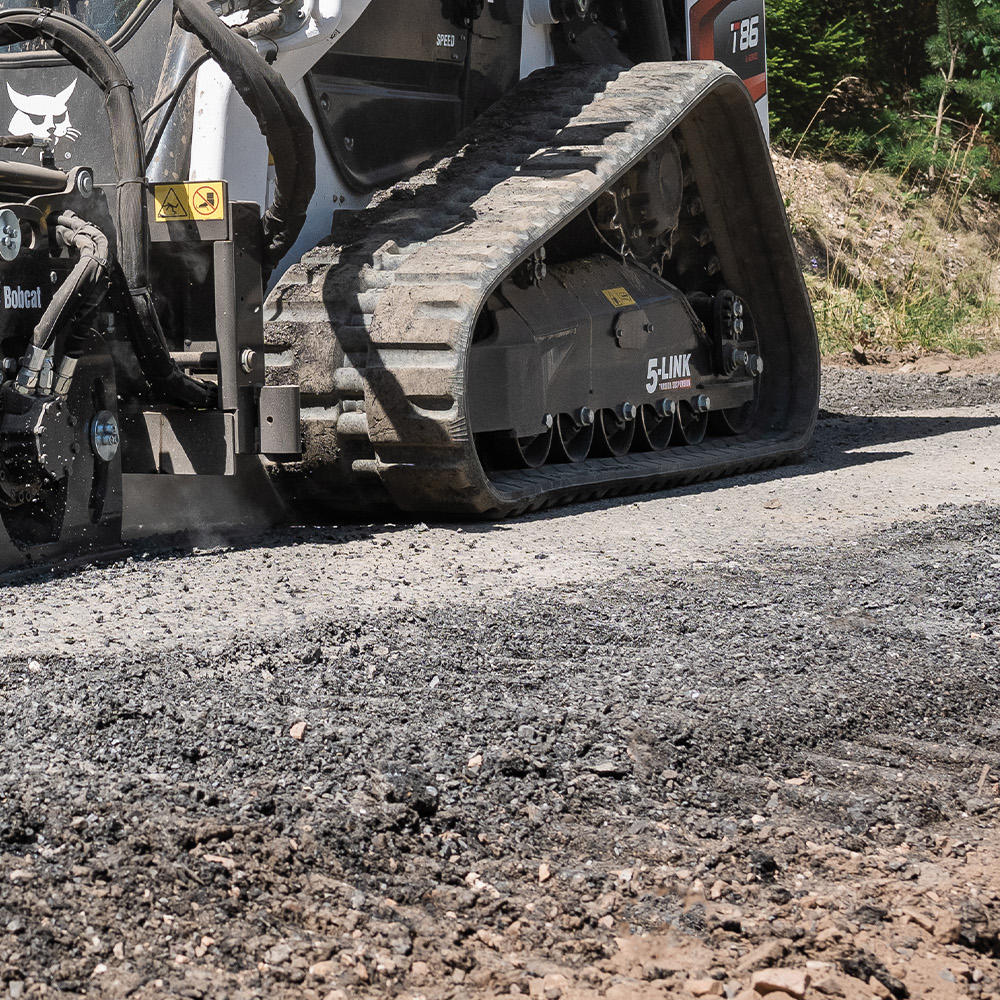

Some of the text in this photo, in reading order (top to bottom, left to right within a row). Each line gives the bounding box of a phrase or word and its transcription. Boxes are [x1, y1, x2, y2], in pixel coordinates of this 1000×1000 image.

[436, 33, 455, 47] SPEED
[730, 16, 759, 54] T86
[3, 286, 42, 309] Bobcat
[645, 353, 692, 394] 5-LINK
